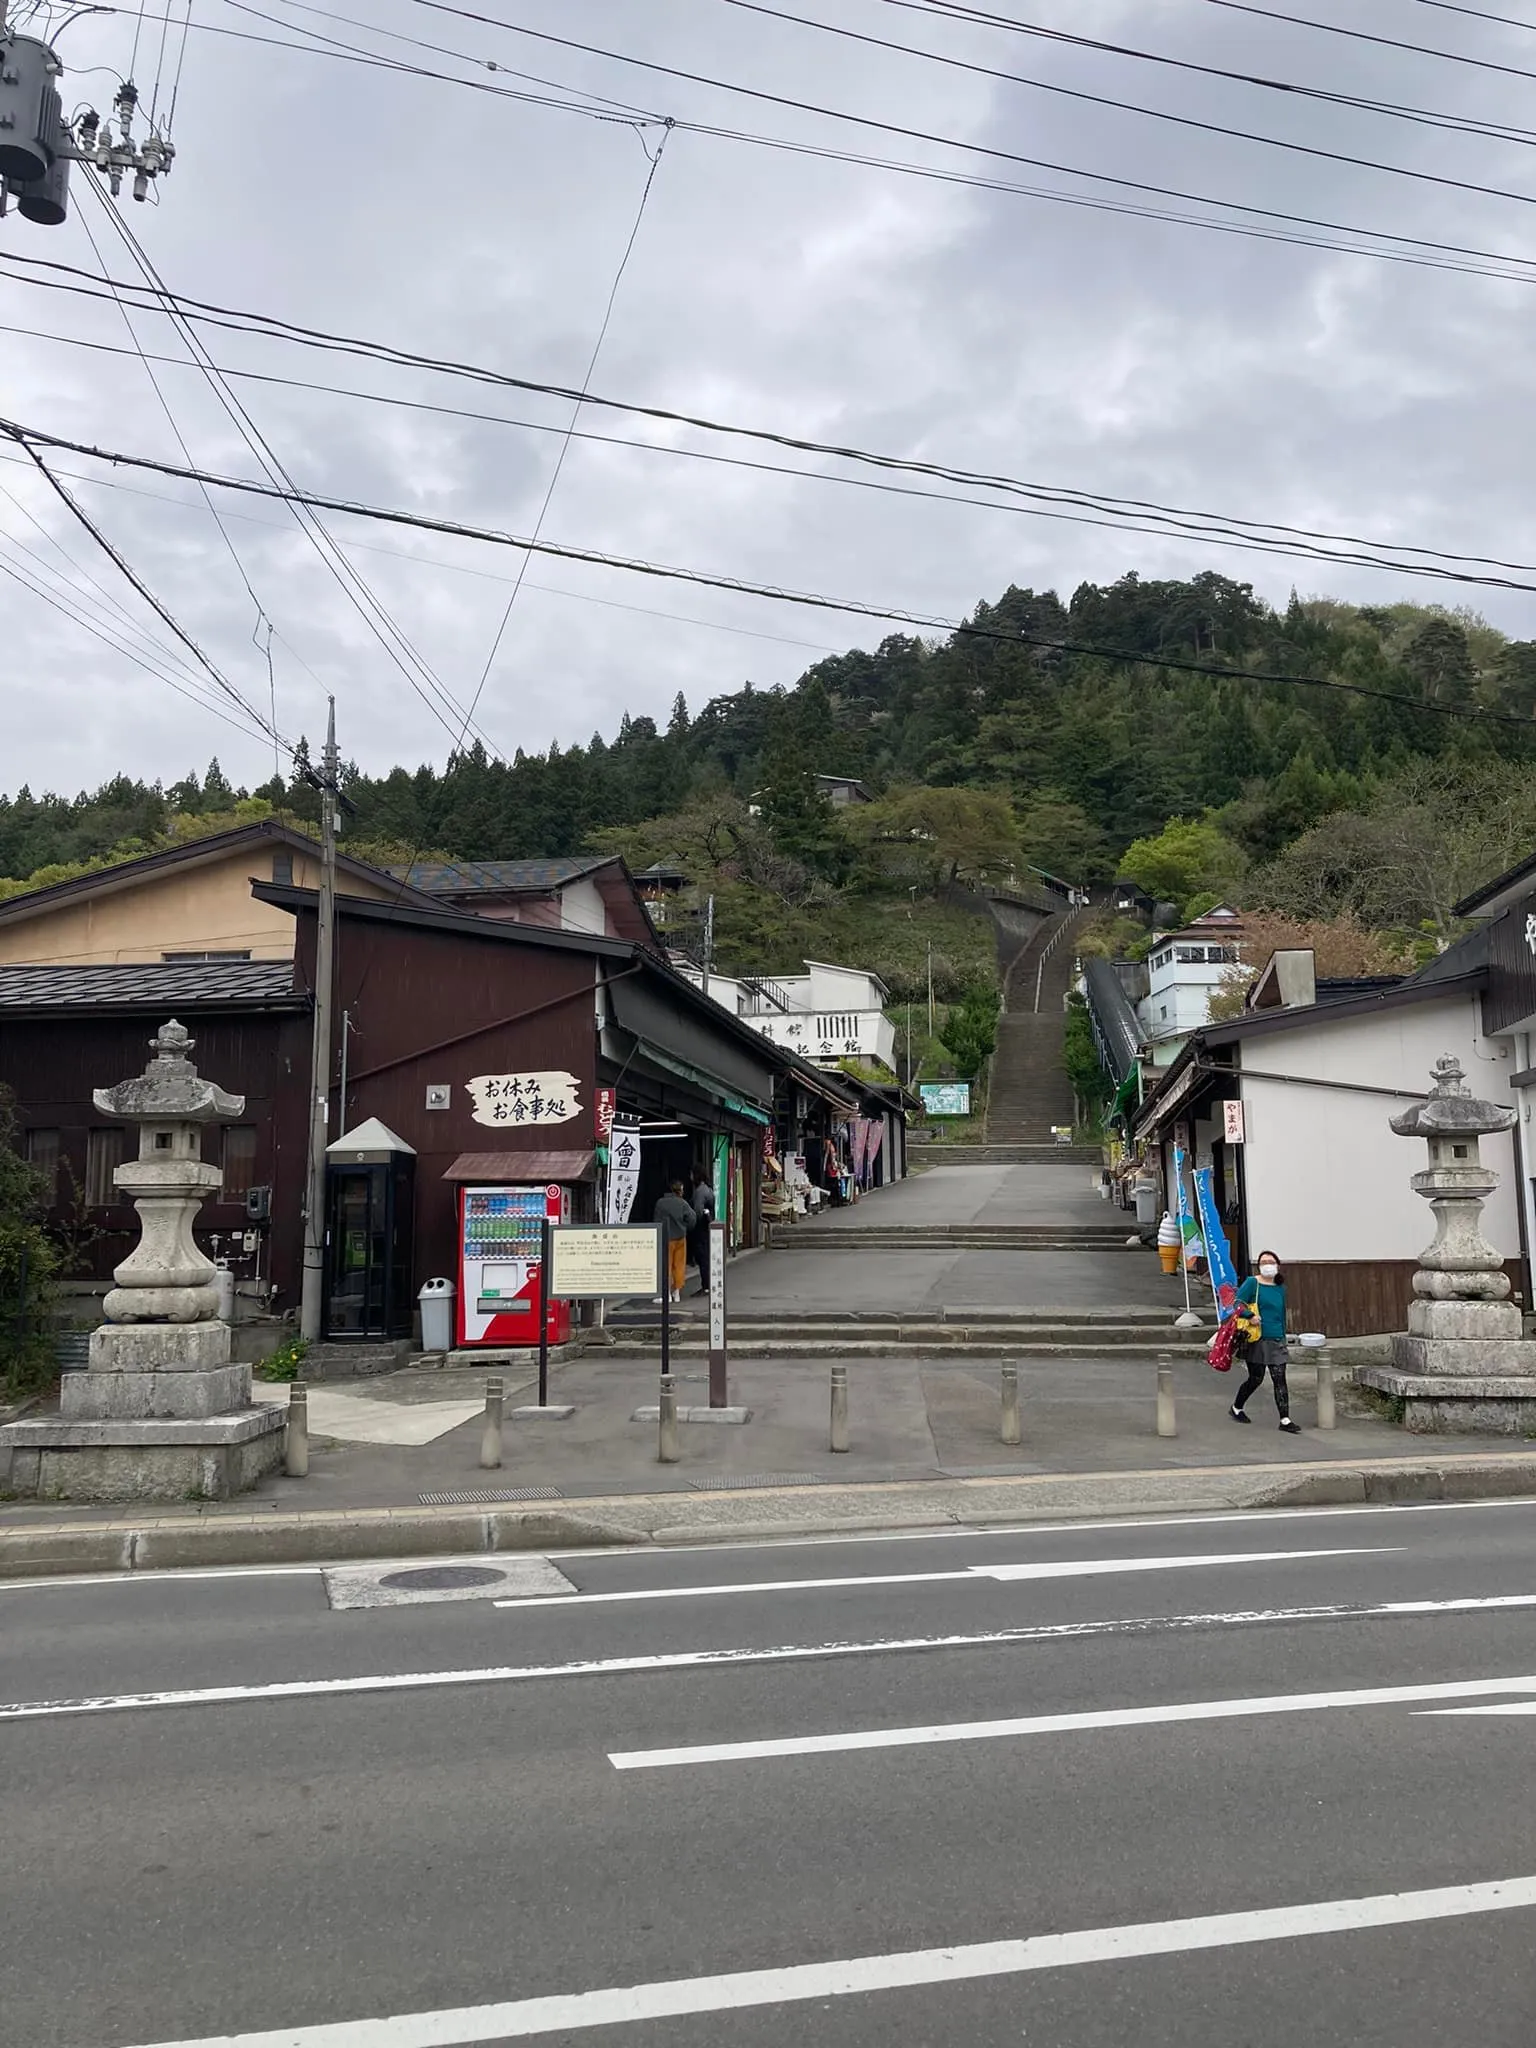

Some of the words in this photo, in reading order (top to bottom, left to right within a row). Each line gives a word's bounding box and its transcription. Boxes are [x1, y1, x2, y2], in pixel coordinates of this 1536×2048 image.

[485, 1078, 541, 1098] お休み
[493, 1095, 567, 1122] お食事処
[1227, 1103, 1238, 1134] やまが
